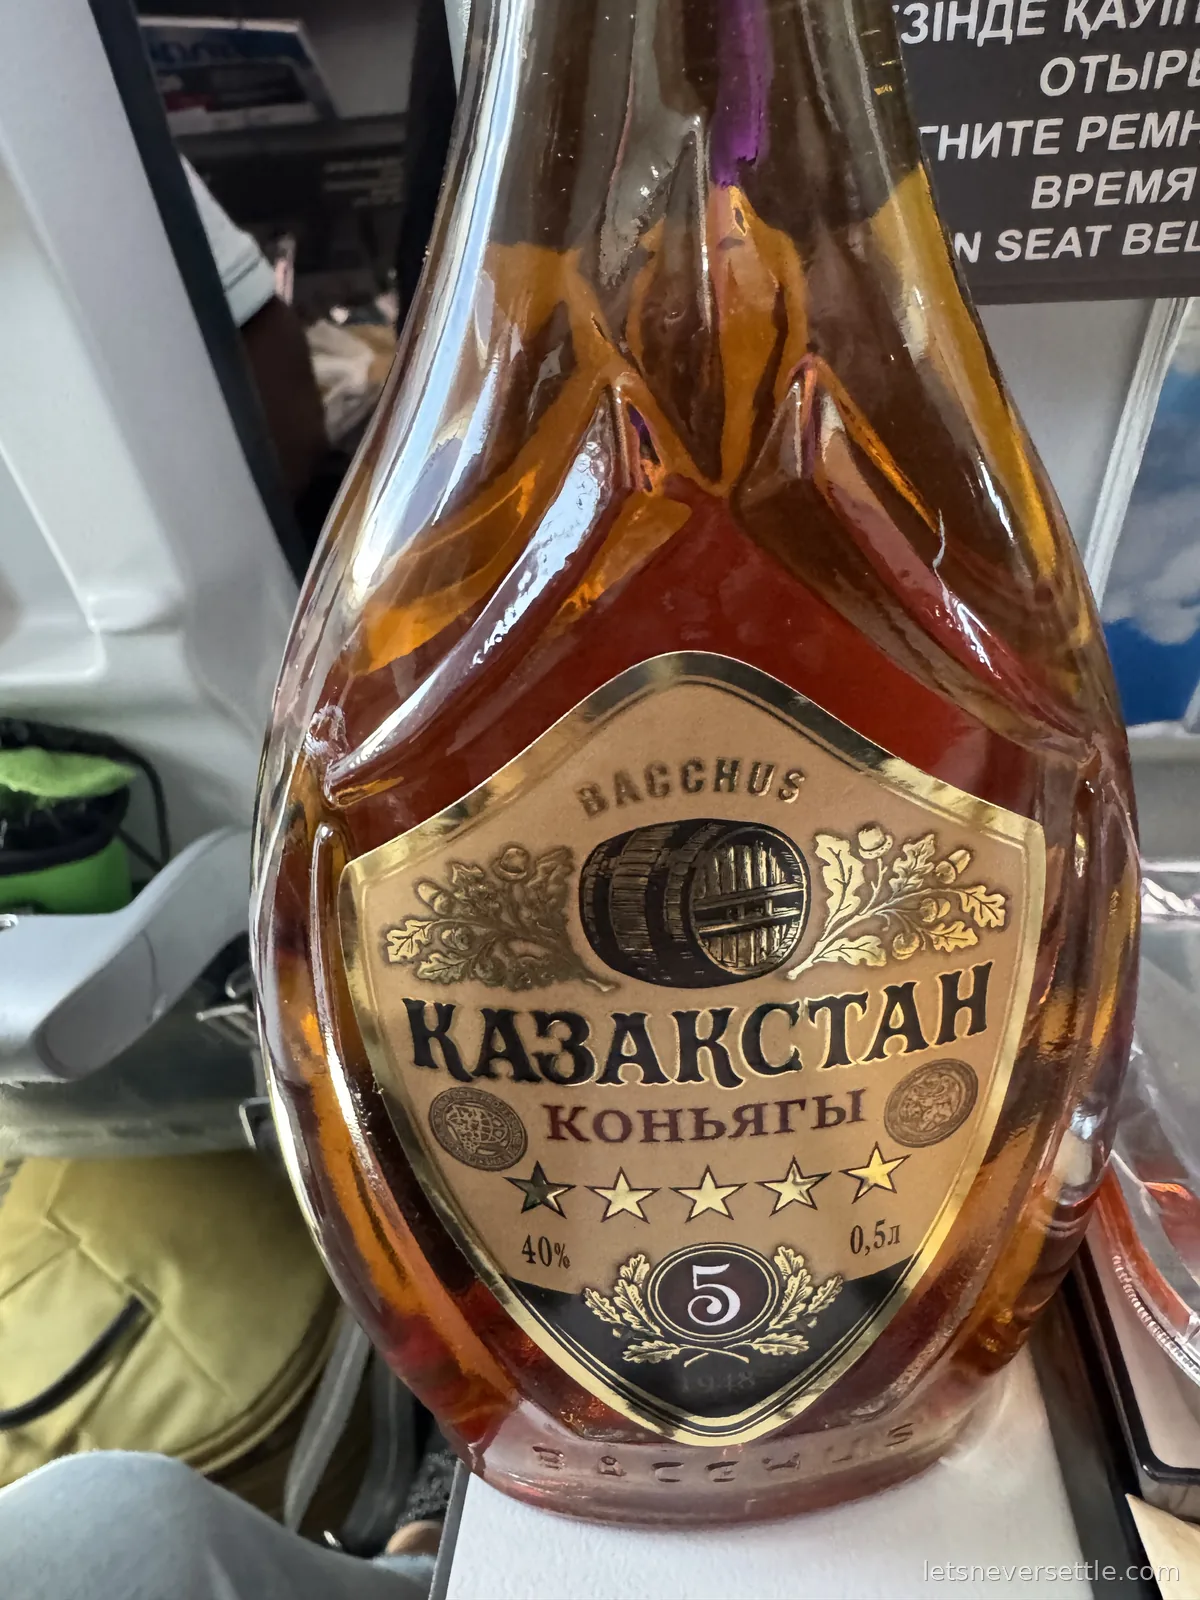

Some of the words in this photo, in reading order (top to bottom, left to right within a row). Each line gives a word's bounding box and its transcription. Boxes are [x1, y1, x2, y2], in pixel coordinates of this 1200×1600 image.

[892, 0, 1046, 47] ЗІНДЕ
[1031, 167, 1198, 209] ВРЕМЯ
[995, 225, 1112, 262] SEAT
[578, 756, 808, 817] BACCHUS
[401, 961, 993, 1089] КАЗАКСТАН
[541, 1088, 868, 1144] КОНЬЯГЫ
[521, 1235, 571, 1268] 40%
[849, 1218, 901, 1256] 0,5л
[686, 1263, 742, 1326] 5
